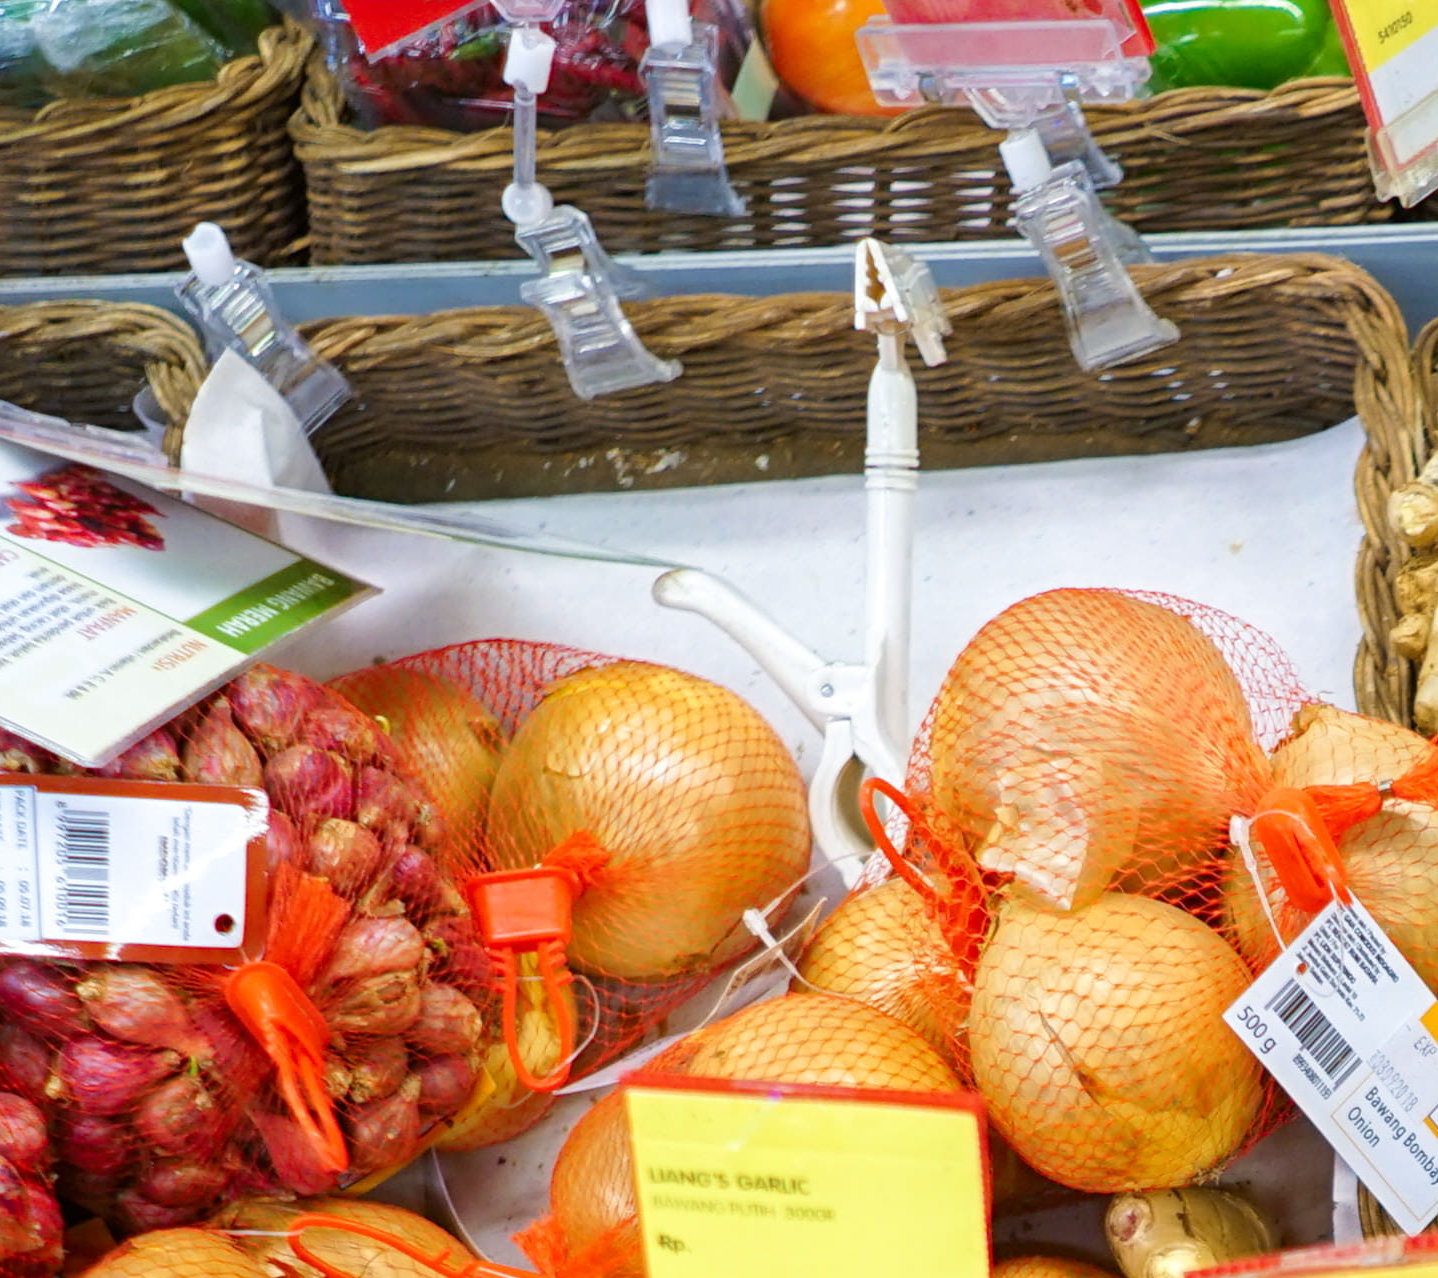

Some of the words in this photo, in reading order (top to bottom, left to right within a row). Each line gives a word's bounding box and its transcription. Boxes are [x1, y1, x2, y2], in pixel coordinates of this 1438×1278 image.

[263, 571, 338, 611] BAWANG
[71, 604, 140, 641] MANFAAT
[213, 602, 281, 638] MERAH
[14, 790, 26, 820] PACK
[16, 822, 28, 849] DATE
[1236, 1006, 1266, 1038] 500
[1262, 1038, 1278, 1054] g
[1413, 1035, 1437, 1057] EXP
[1348, 1105, 1381, 1149] Onion
[1364, 1086, 1408, 1140] Bawang
[647, 1167, 732, 1190] LIANG'S
[735, 1173, 811, 1196] GARLIC
[658, 1235, 692, 1253] Rp.
